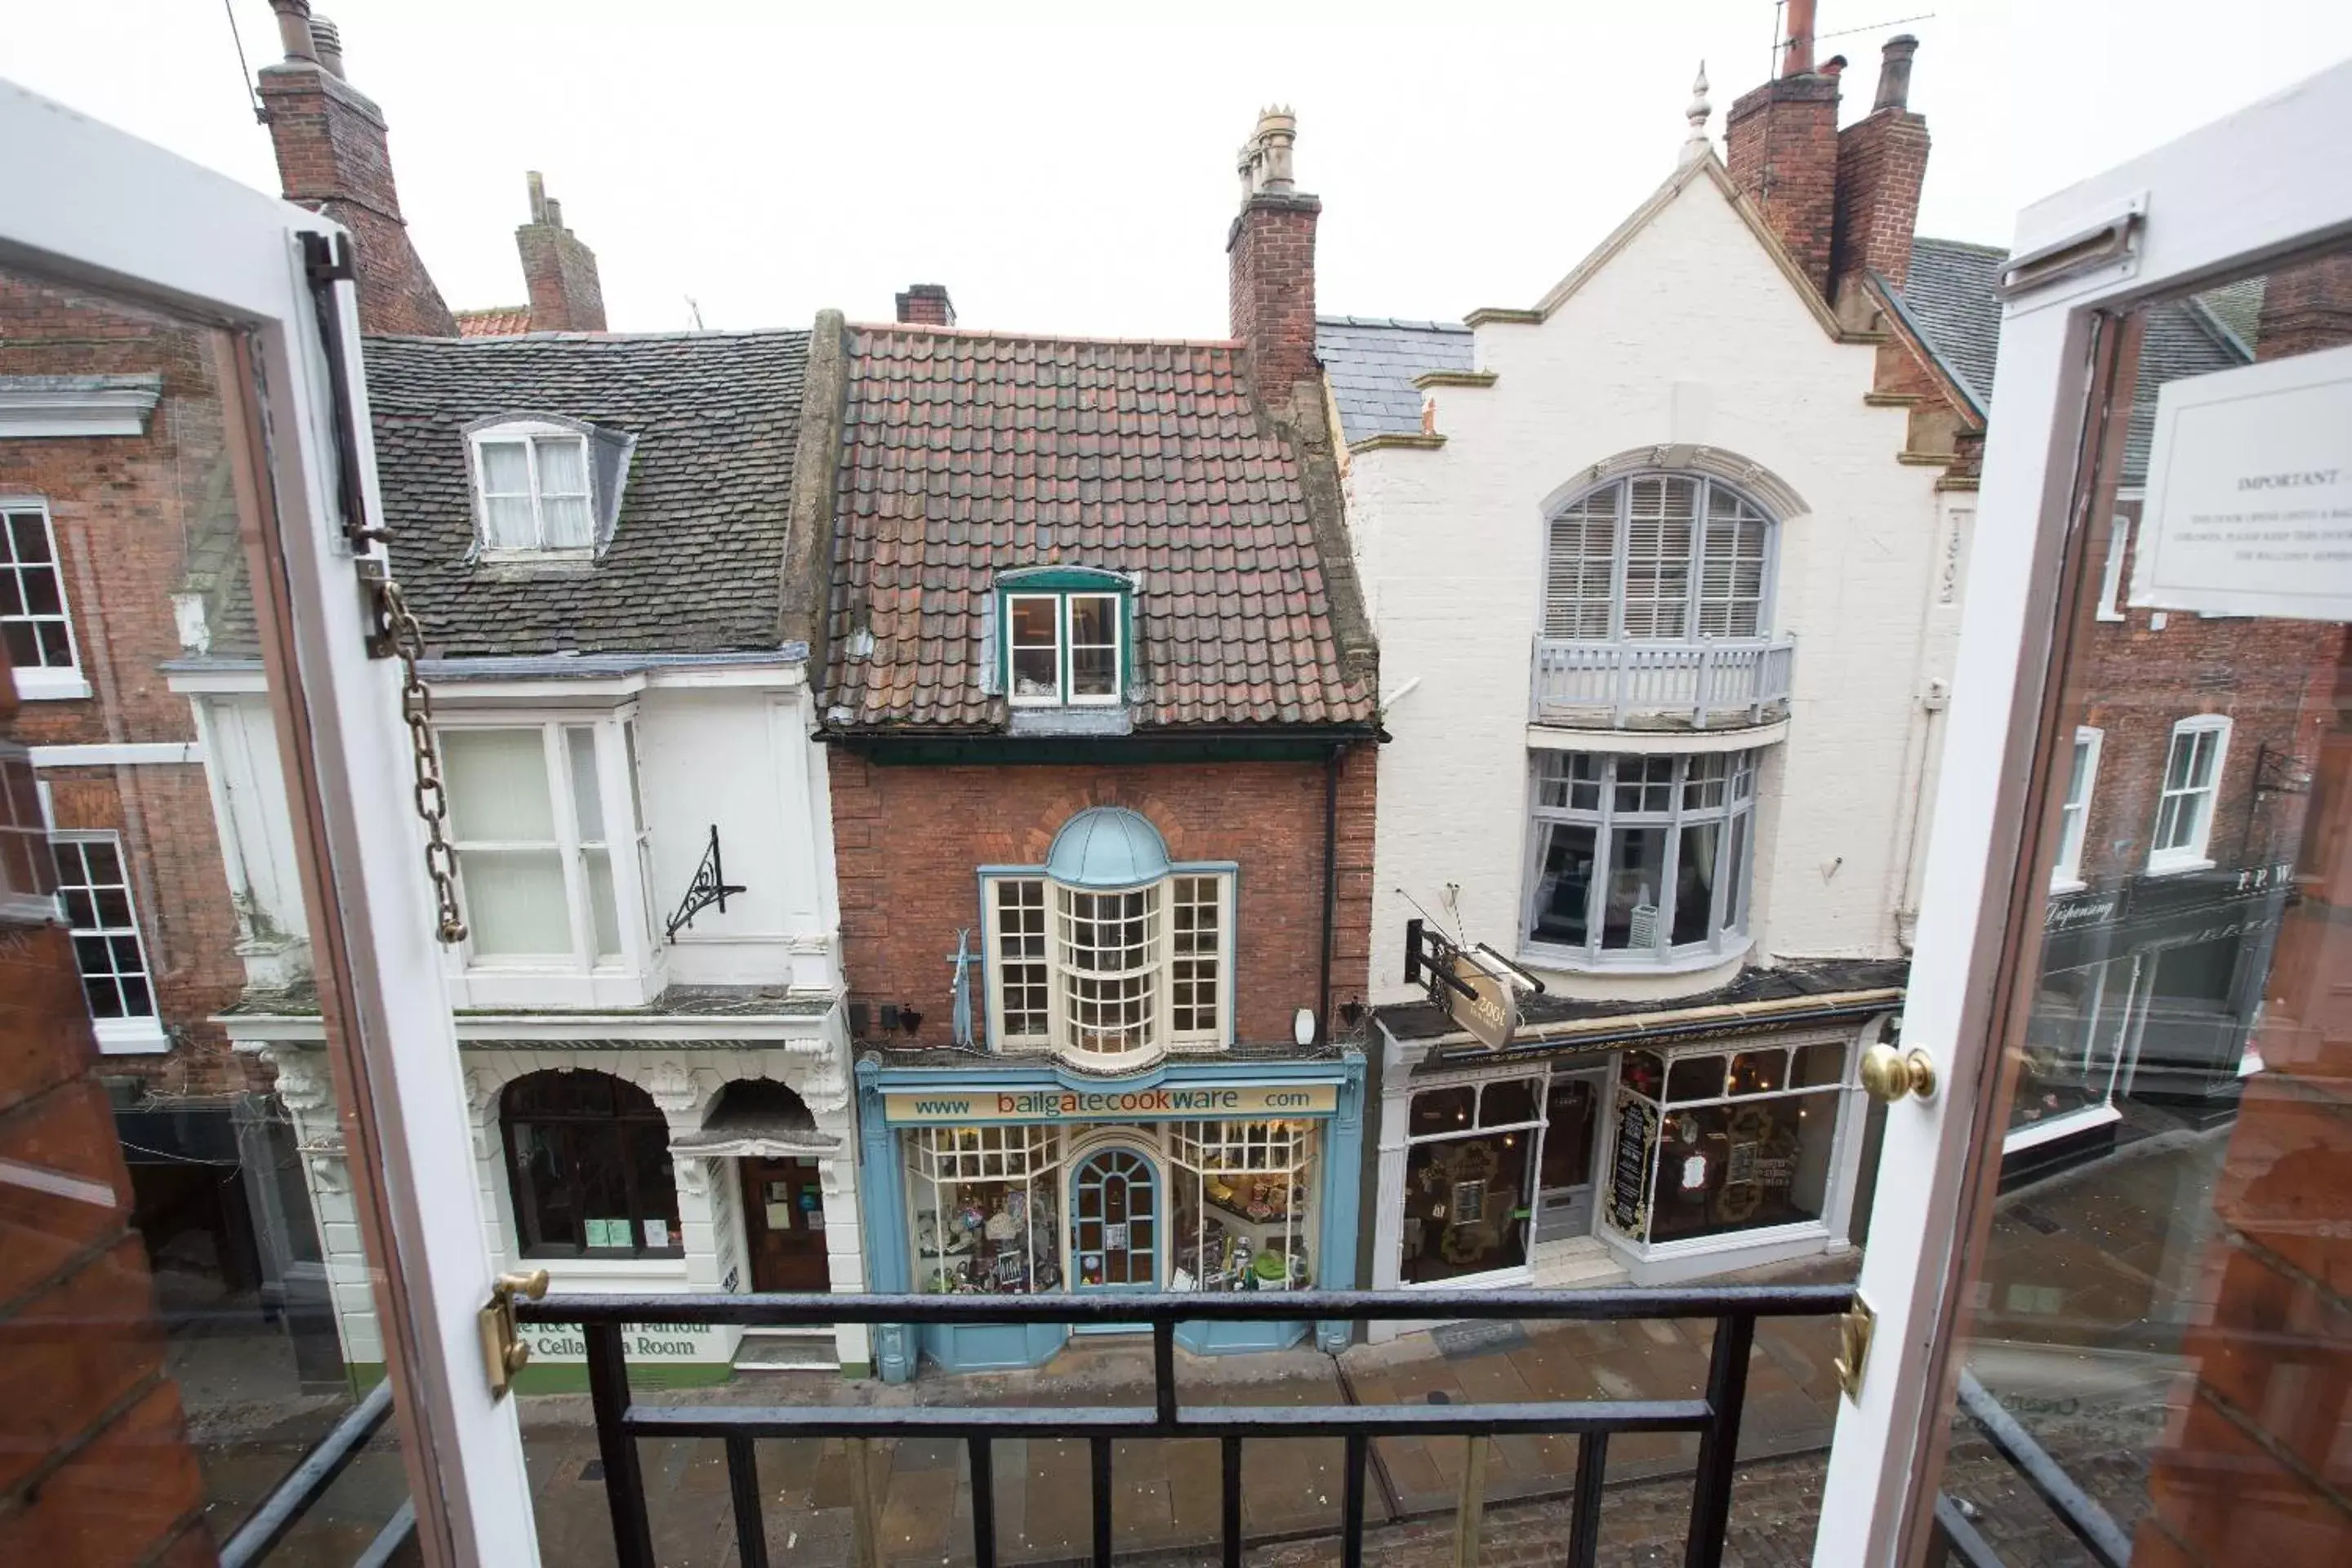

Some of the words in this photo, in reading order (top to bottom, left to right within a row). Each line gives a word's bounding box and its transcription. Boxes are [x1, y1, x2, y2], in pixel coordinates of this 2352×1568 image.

[2237, 469, 2341, 491] IMPORTANT
[998, 1089, 1238, 1117] bailgatecookware
[538, 1338, 586, 1355] Cella
[637, 1337, 694, 1355] Room
